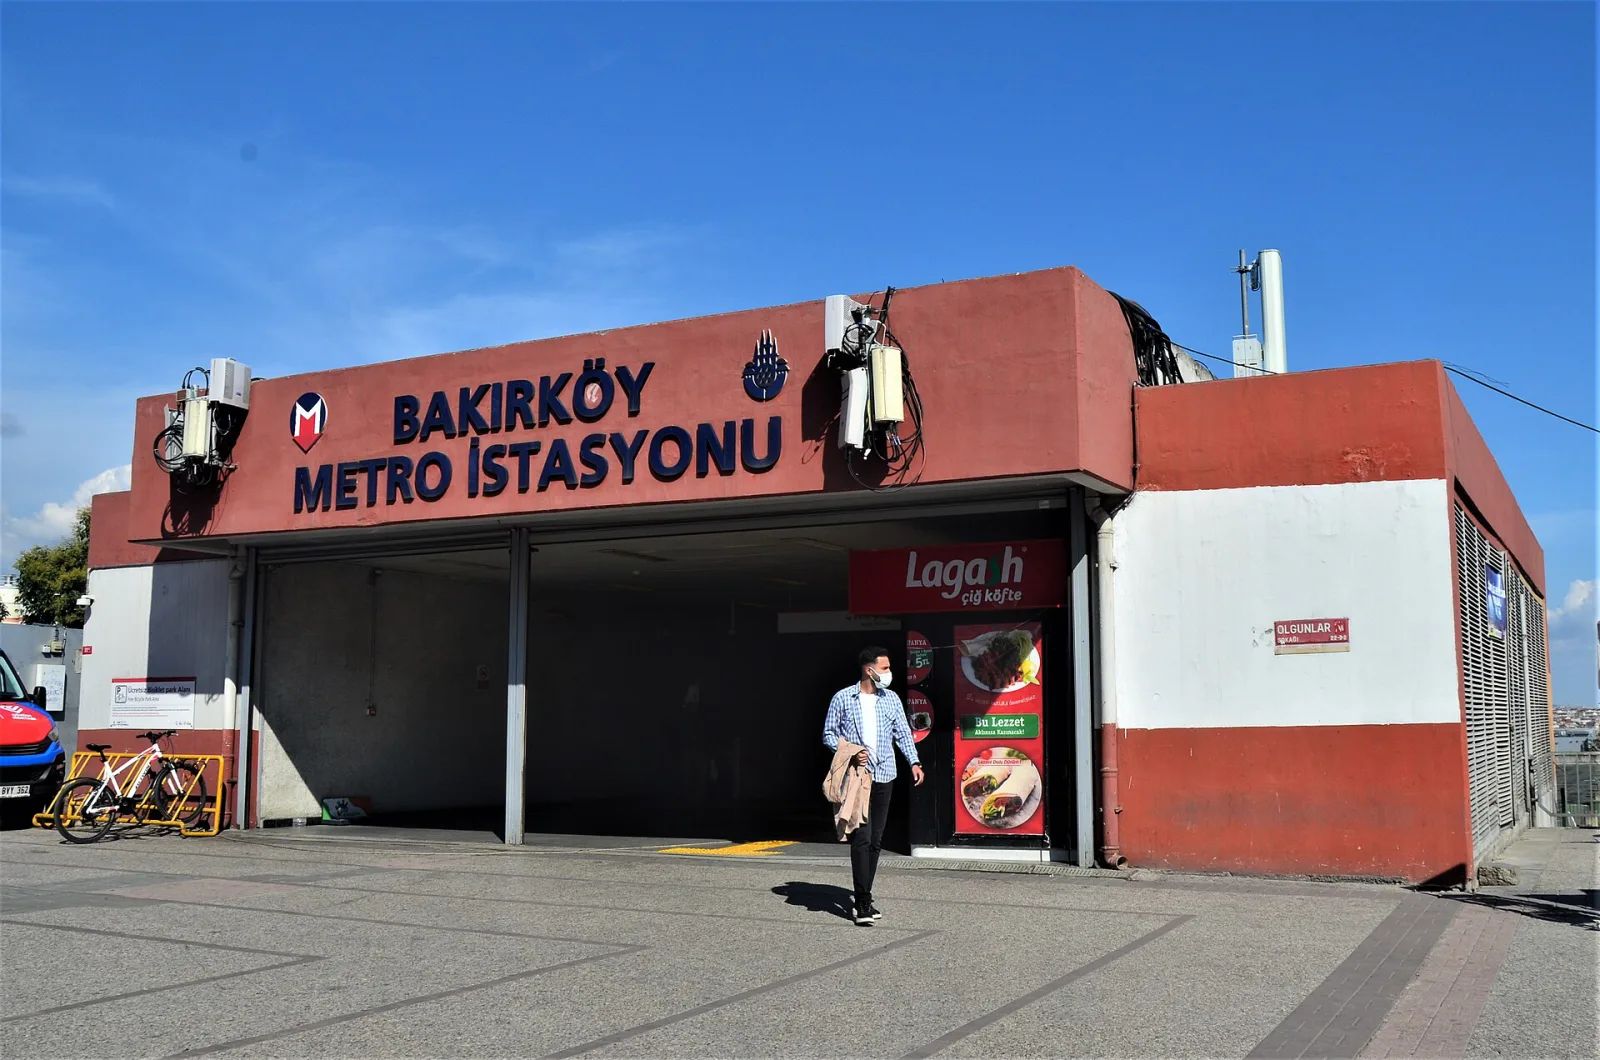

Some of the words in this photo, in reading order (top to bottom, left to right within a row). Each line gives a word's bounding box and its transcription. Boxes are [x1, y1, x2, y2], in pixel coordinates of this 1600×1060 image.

[393, 358, 655, 445] BAKIRKÖY
[293, 451, 453, 514] METRO
[467, 416, 782, 499] İSTASYONU
[905, 545, 1023, 599] Lagash
[961, 588, 982, 606] çiğ
[984, 587, 1022, 606] köfte
[1277, 623, 1331, 634] OLGUNLAR
[975, 717, 989, 727] Bu
[991, 716, 1025, 727] Lezzet
